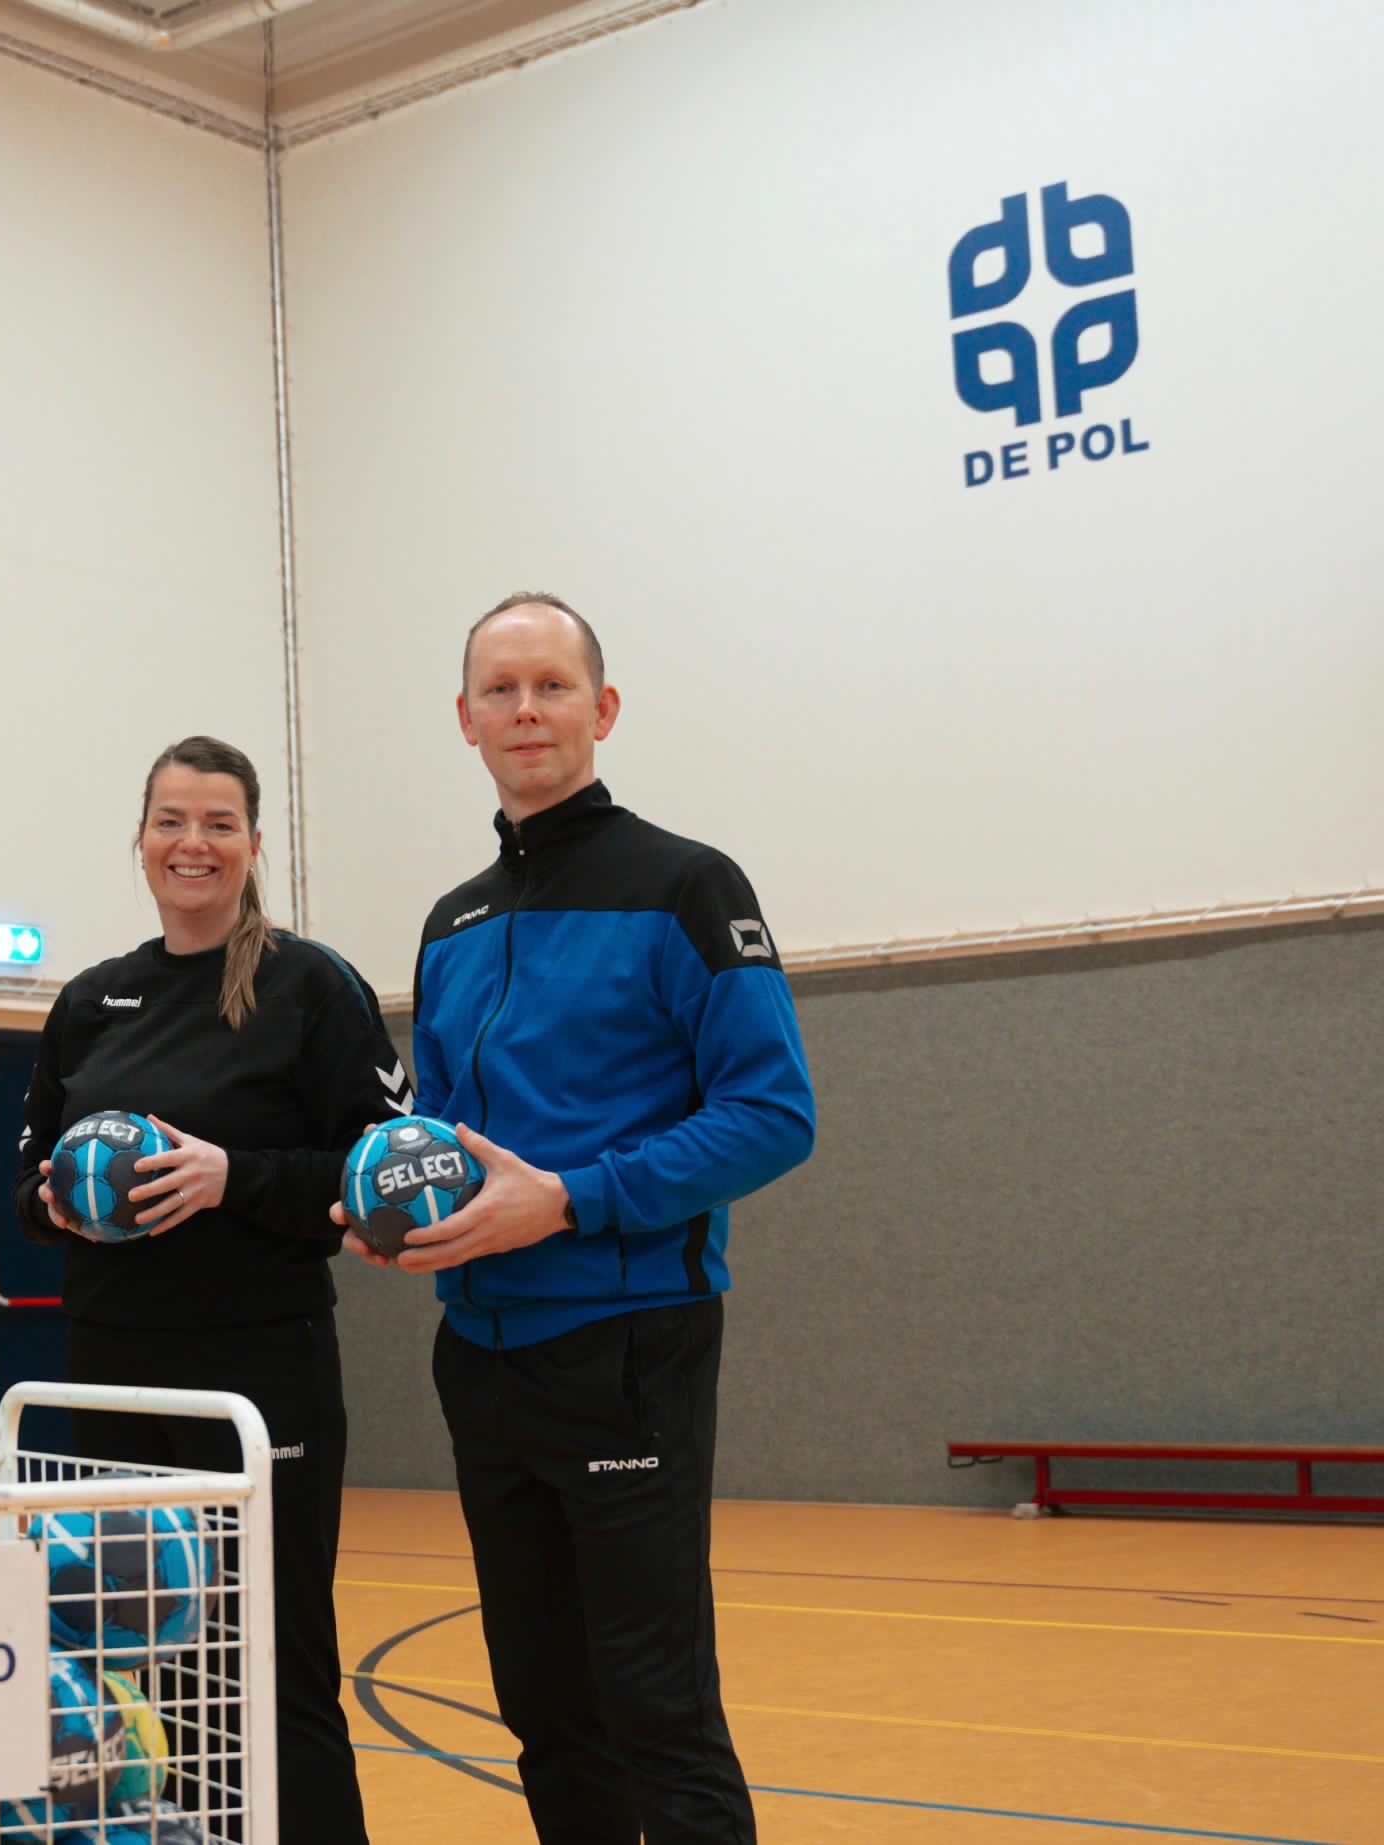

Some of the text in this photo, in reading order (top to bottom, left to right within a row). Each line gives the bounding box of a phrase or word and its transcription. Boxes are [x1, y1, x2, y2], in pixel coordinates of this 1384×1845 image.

[963, 417, 1150, 488] DE POL
[102, 994, 143, 1009] hummel
[63, 1119, 141, 1148] SELECT
[377, 1151, 464, 1196] SELECT
[271, 1441, 305, 1460] mmel
[587, 1456, 659, 1473] STANNO
